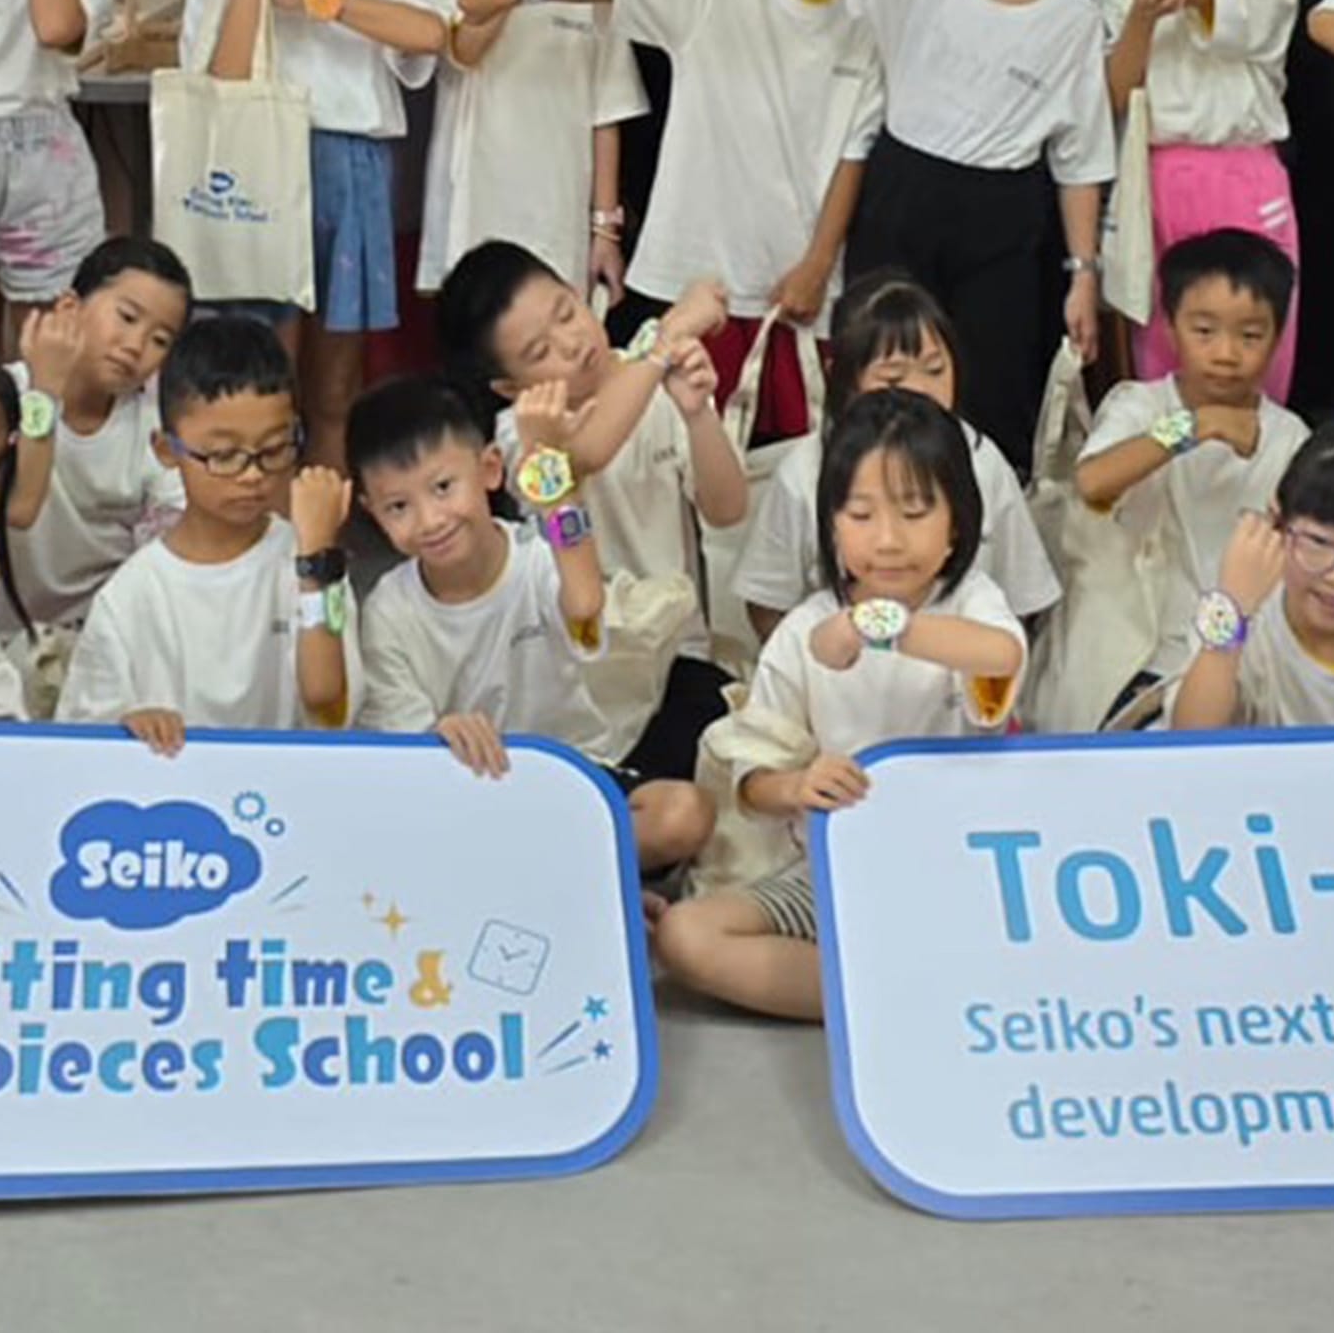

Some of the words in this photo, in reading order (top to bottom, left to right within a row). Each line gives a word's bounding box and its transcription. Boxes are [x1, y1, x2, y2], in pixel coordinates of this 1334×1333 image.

[77, 840, 231, 891] Seiko
[216, 938, 395, 1010] time
[408, 950, 455, 1008] &
[257, 1012, 527, 1087] School
[965, 994, 1180, 1055] Seiko's
